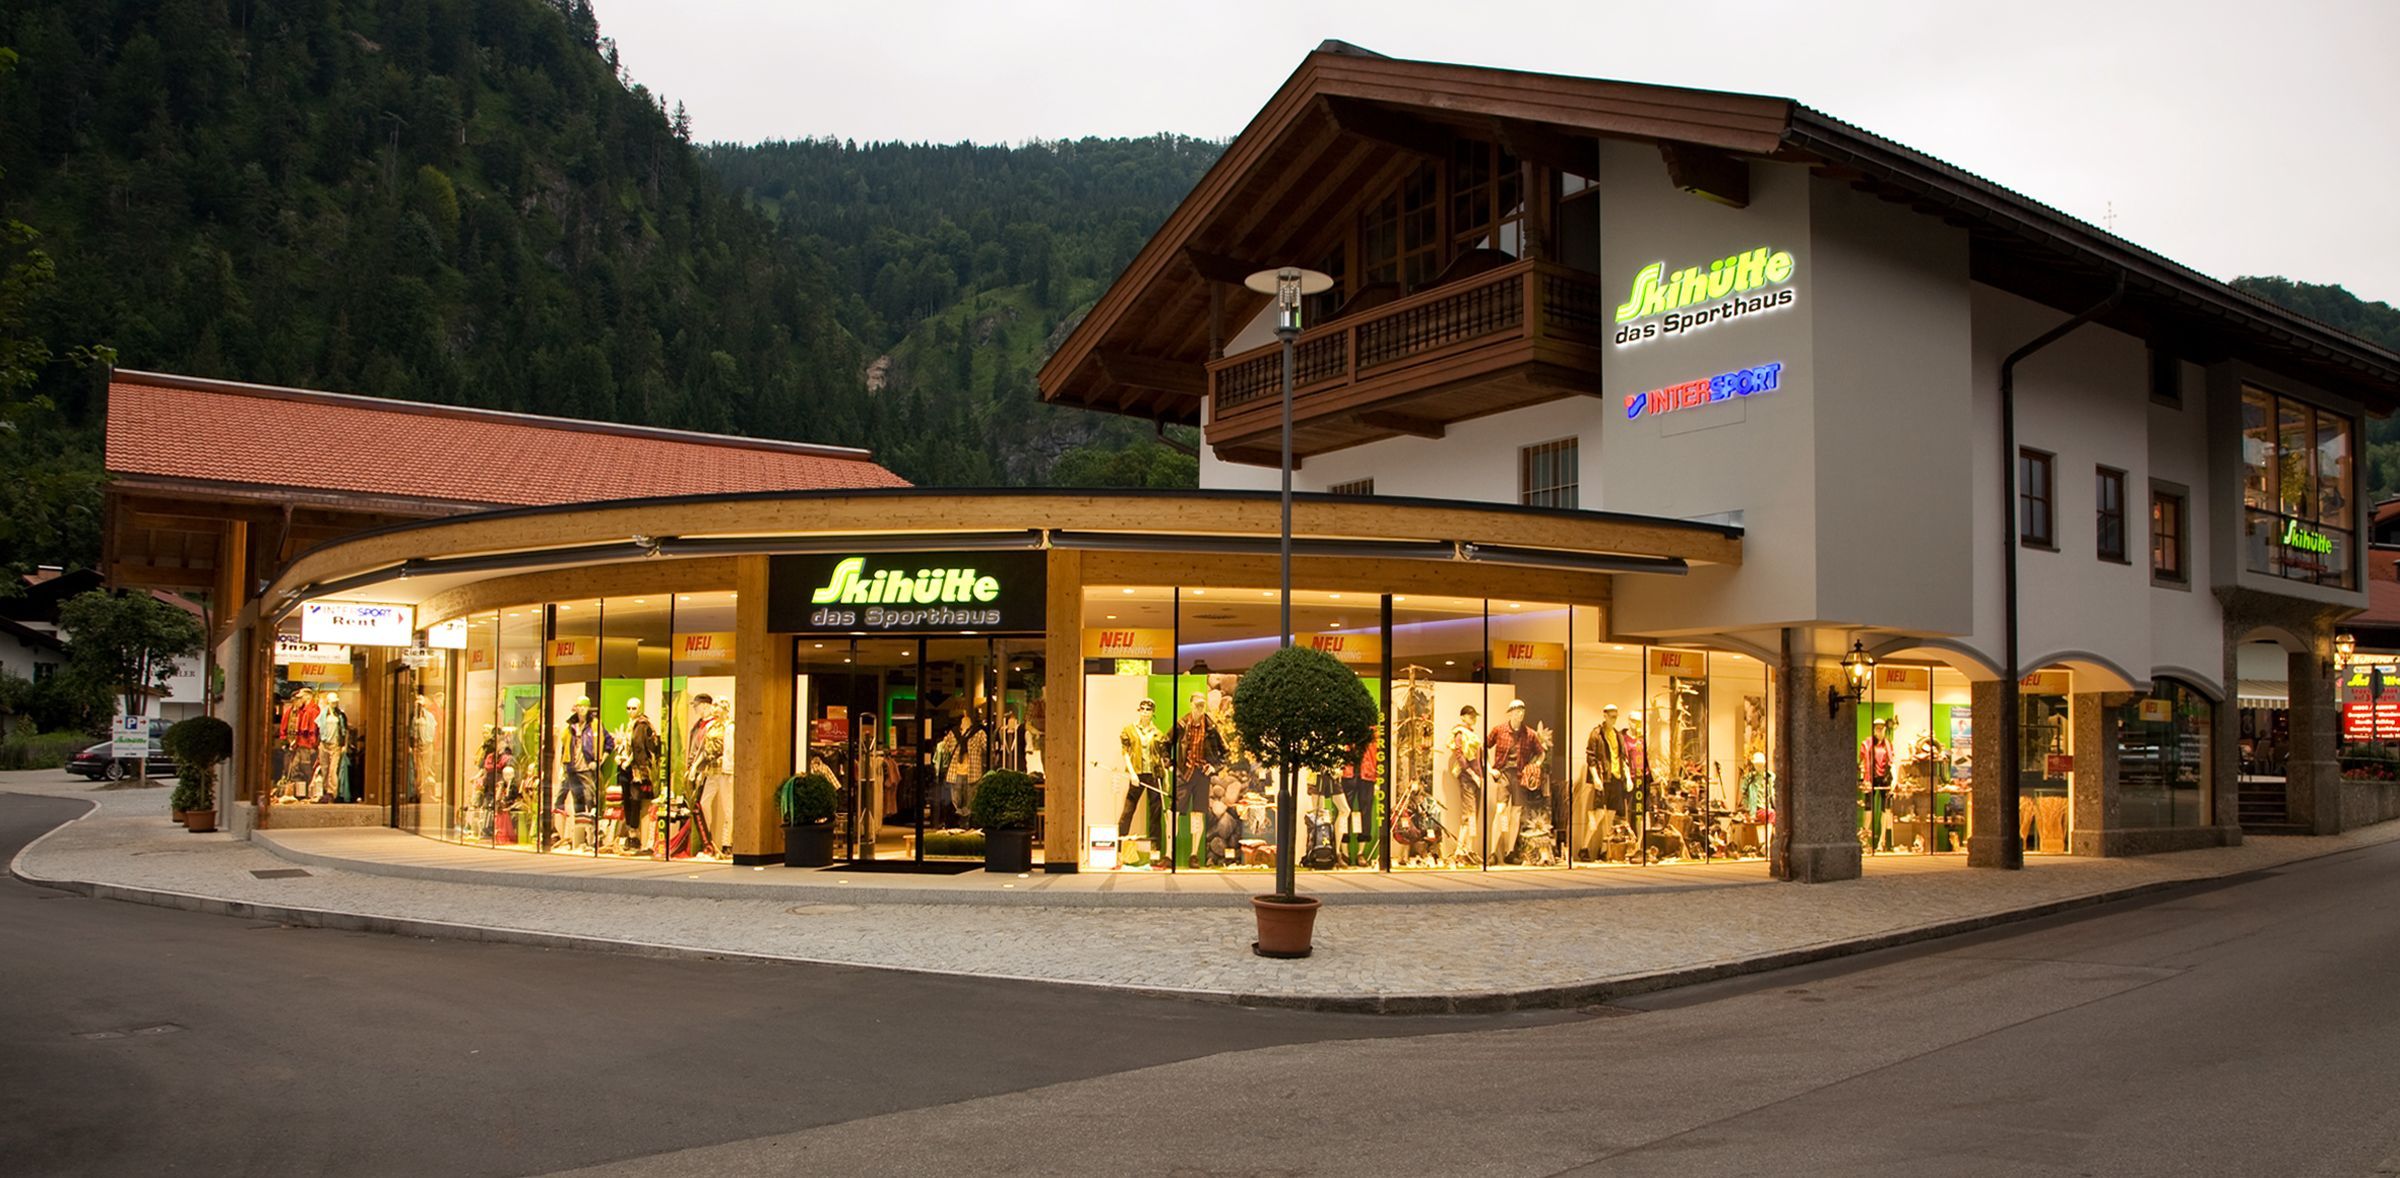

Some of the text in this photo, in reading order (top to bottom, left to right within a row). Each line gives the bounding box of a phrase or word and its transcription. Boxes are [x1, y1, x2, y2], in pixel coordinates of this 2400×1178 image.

[1615, 248, 1793, 323] Skihütte
[1615, 289, 1793, 345] das Sporthaus
[1647, 362, 1781, 415] INTERSPORT
[2283, 519, 2332, 555] Skihütte
[811, 557, 1000, 604] Skihütte
[323, 606, 392, 618] INTERSPORT
[811, 606, 1001, 629] das Sporthaus
[332, 616, 377, 627] Rent
[685, 635, 712, 651] NEU
[1099, 631, 1135, 648] NEU
[1312, 635, 1345, 652] NEU
[556, 642, 575, 657] NEU
[1507, 643, 1534, 659] NEU
[1660, 652, 1681, 668] NEU
[301, 665, 326, 675] NEU
[1886, 669, 1906, 683] NEU
[127, 718, 136, 729] P
[1376, 712, 1386, 827] BERGSPORT
